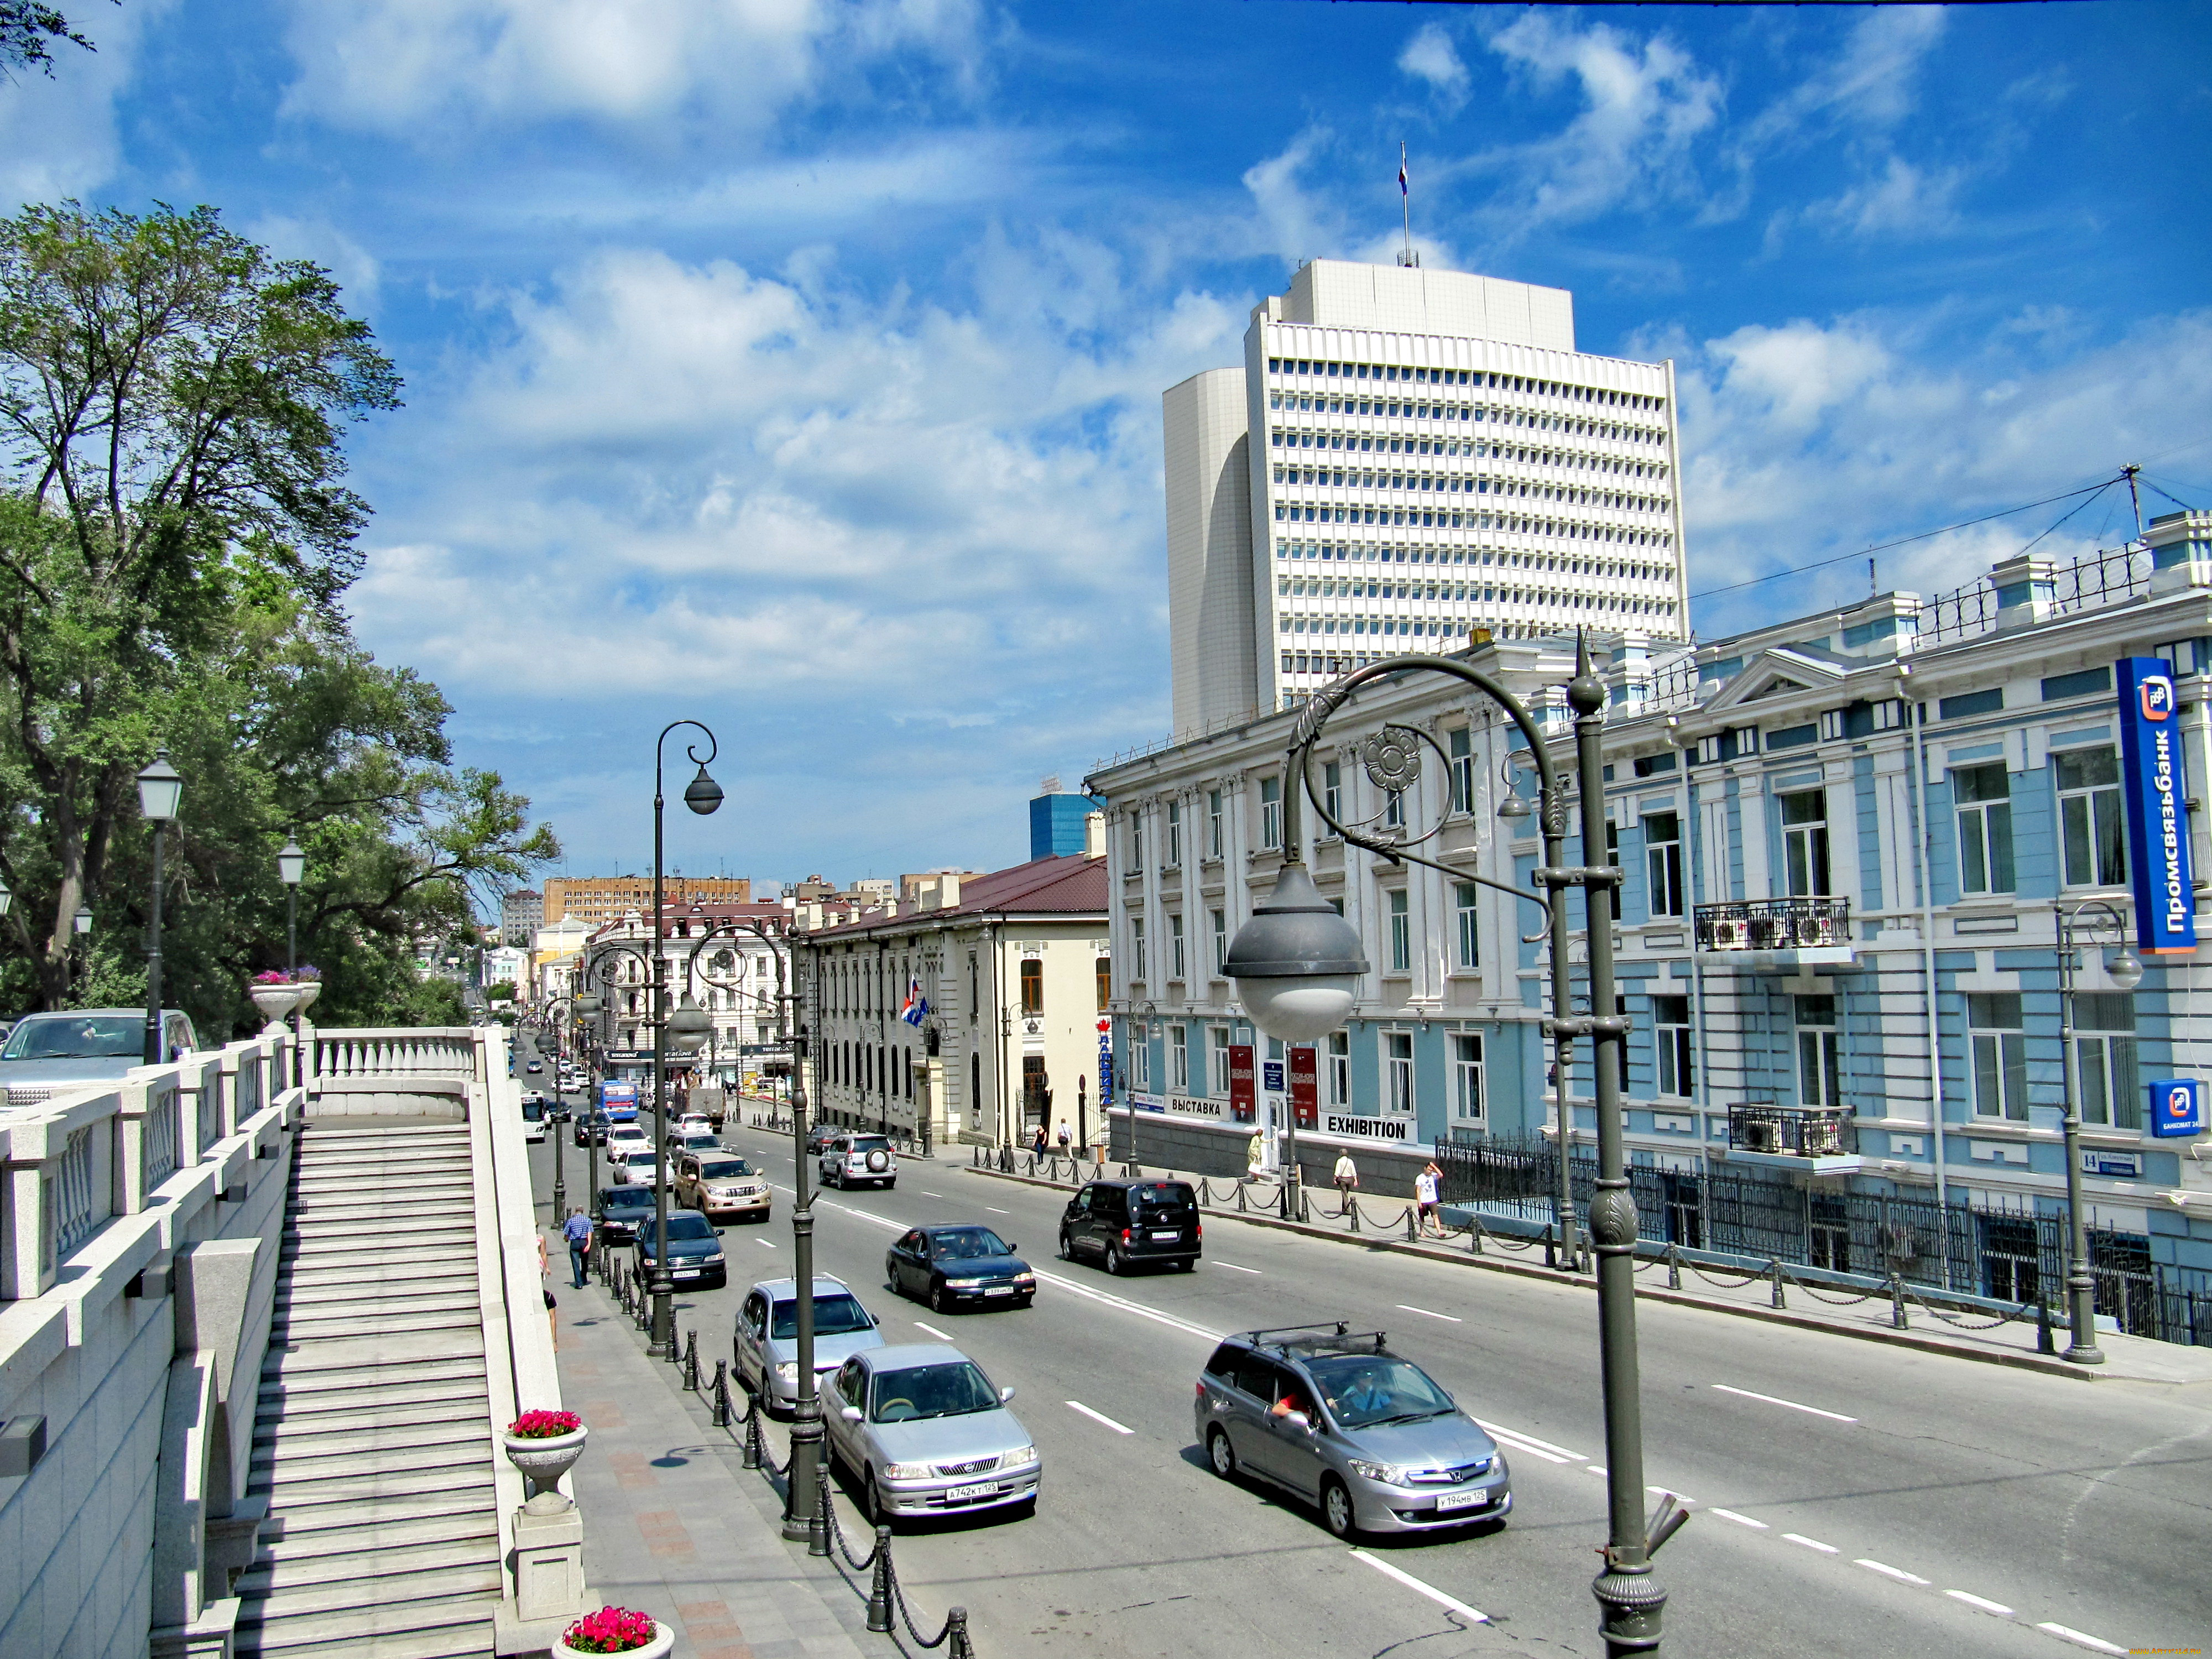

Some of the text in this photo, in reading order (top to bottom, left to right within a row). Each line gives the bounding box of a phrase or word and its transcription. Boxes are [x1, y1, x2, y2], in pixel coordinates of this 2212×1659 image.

[2154, 729, 2184, 933] Промсвязьбанк
[1172, 1099, 1220, 1116] ВЫСТАВКА
[1328, 1116, 1405, 1139] EXHIBITION
[2163, 1121, 2191, 1130] БАНКОМАТ
[2084, 1154, 2096, 1167] 14
